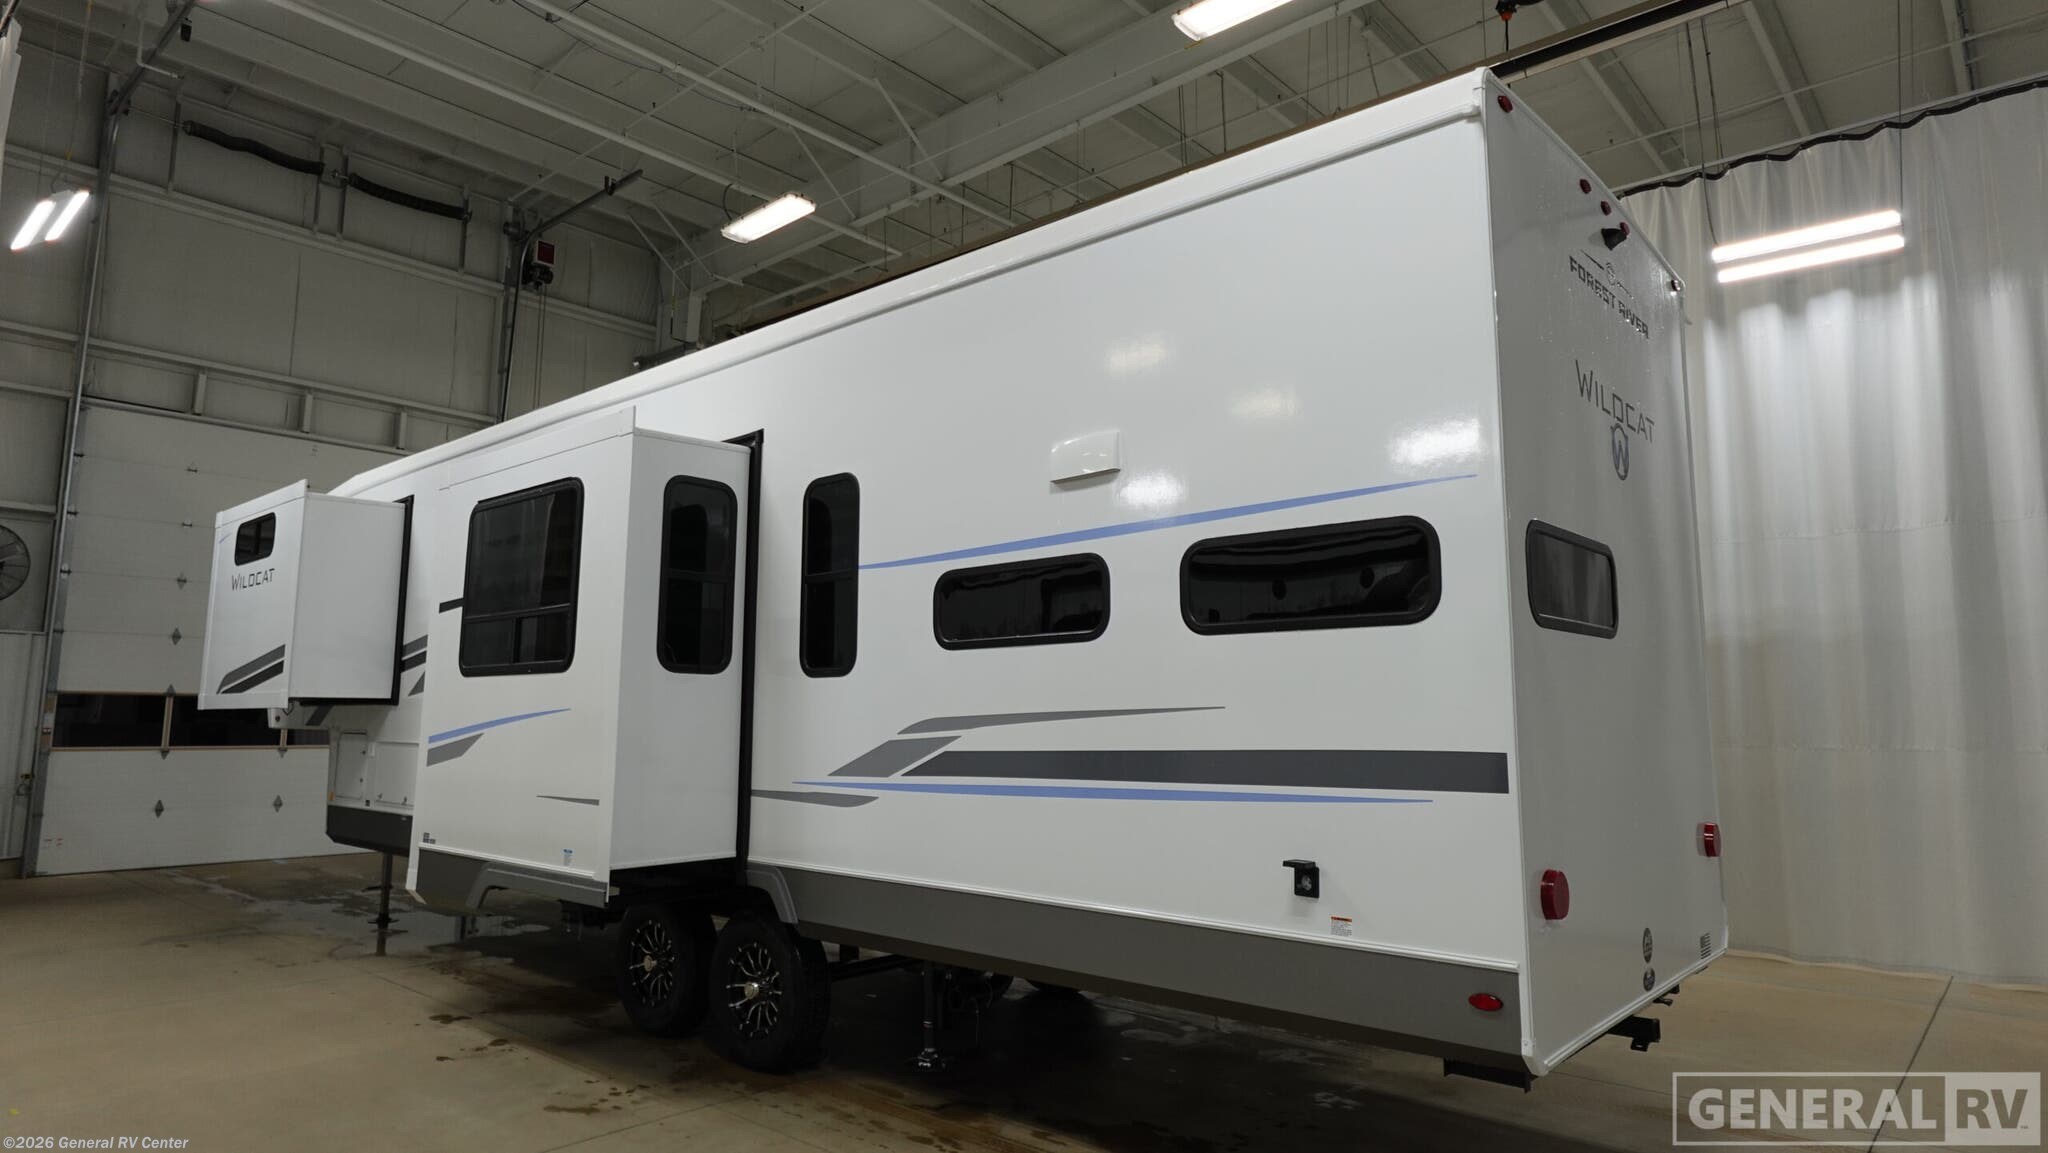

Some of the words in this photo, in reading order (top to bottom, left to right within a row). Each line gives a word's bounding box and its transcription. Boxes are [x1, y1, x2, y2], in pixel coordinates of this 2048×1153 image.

[1568, 254, 1616, 309] FOREST
[1618, 300, 1649, 339] RIVER
[1575, 358, 1655, 444] WILDCAT
[231, 567, 276, 591] WILDCAT
